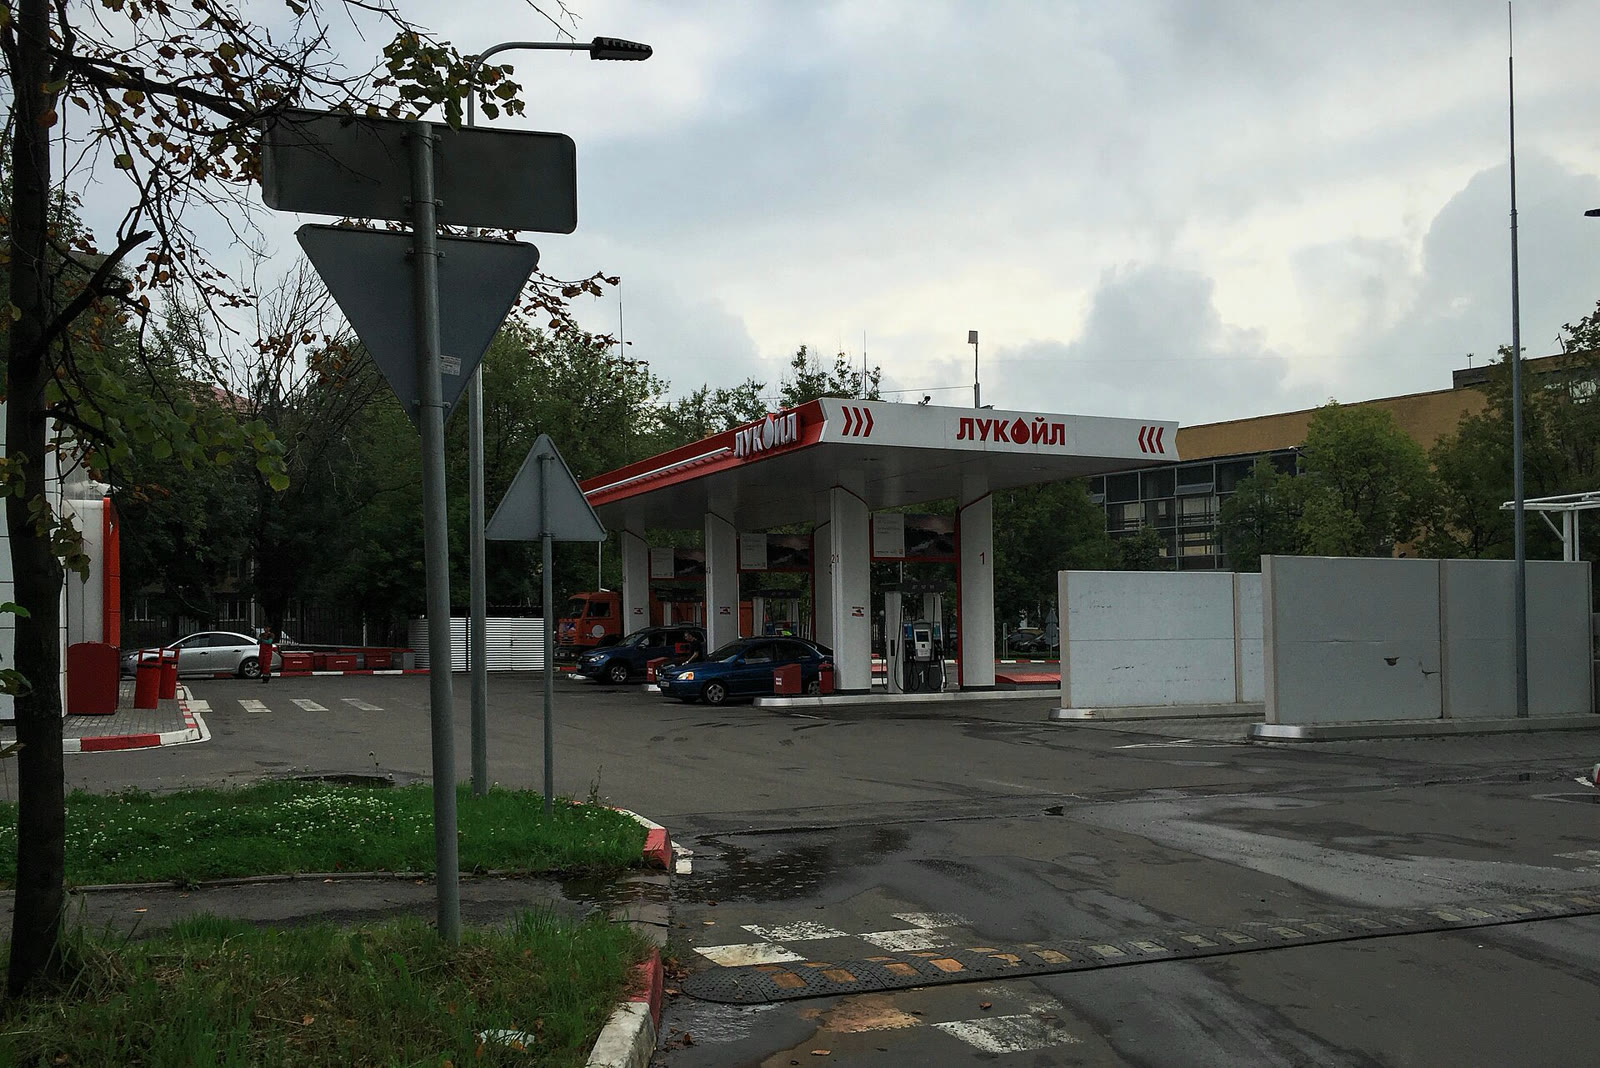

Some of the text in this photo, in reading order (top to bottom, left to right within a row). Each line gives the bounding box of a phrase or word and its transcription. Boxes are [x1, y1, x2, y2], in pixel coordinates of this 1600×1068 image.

[957, 417, 1066, 446] ЛУКОЙЛ
[979, 551, 985, 565] 1
[918, 670, 925, 683] 1
